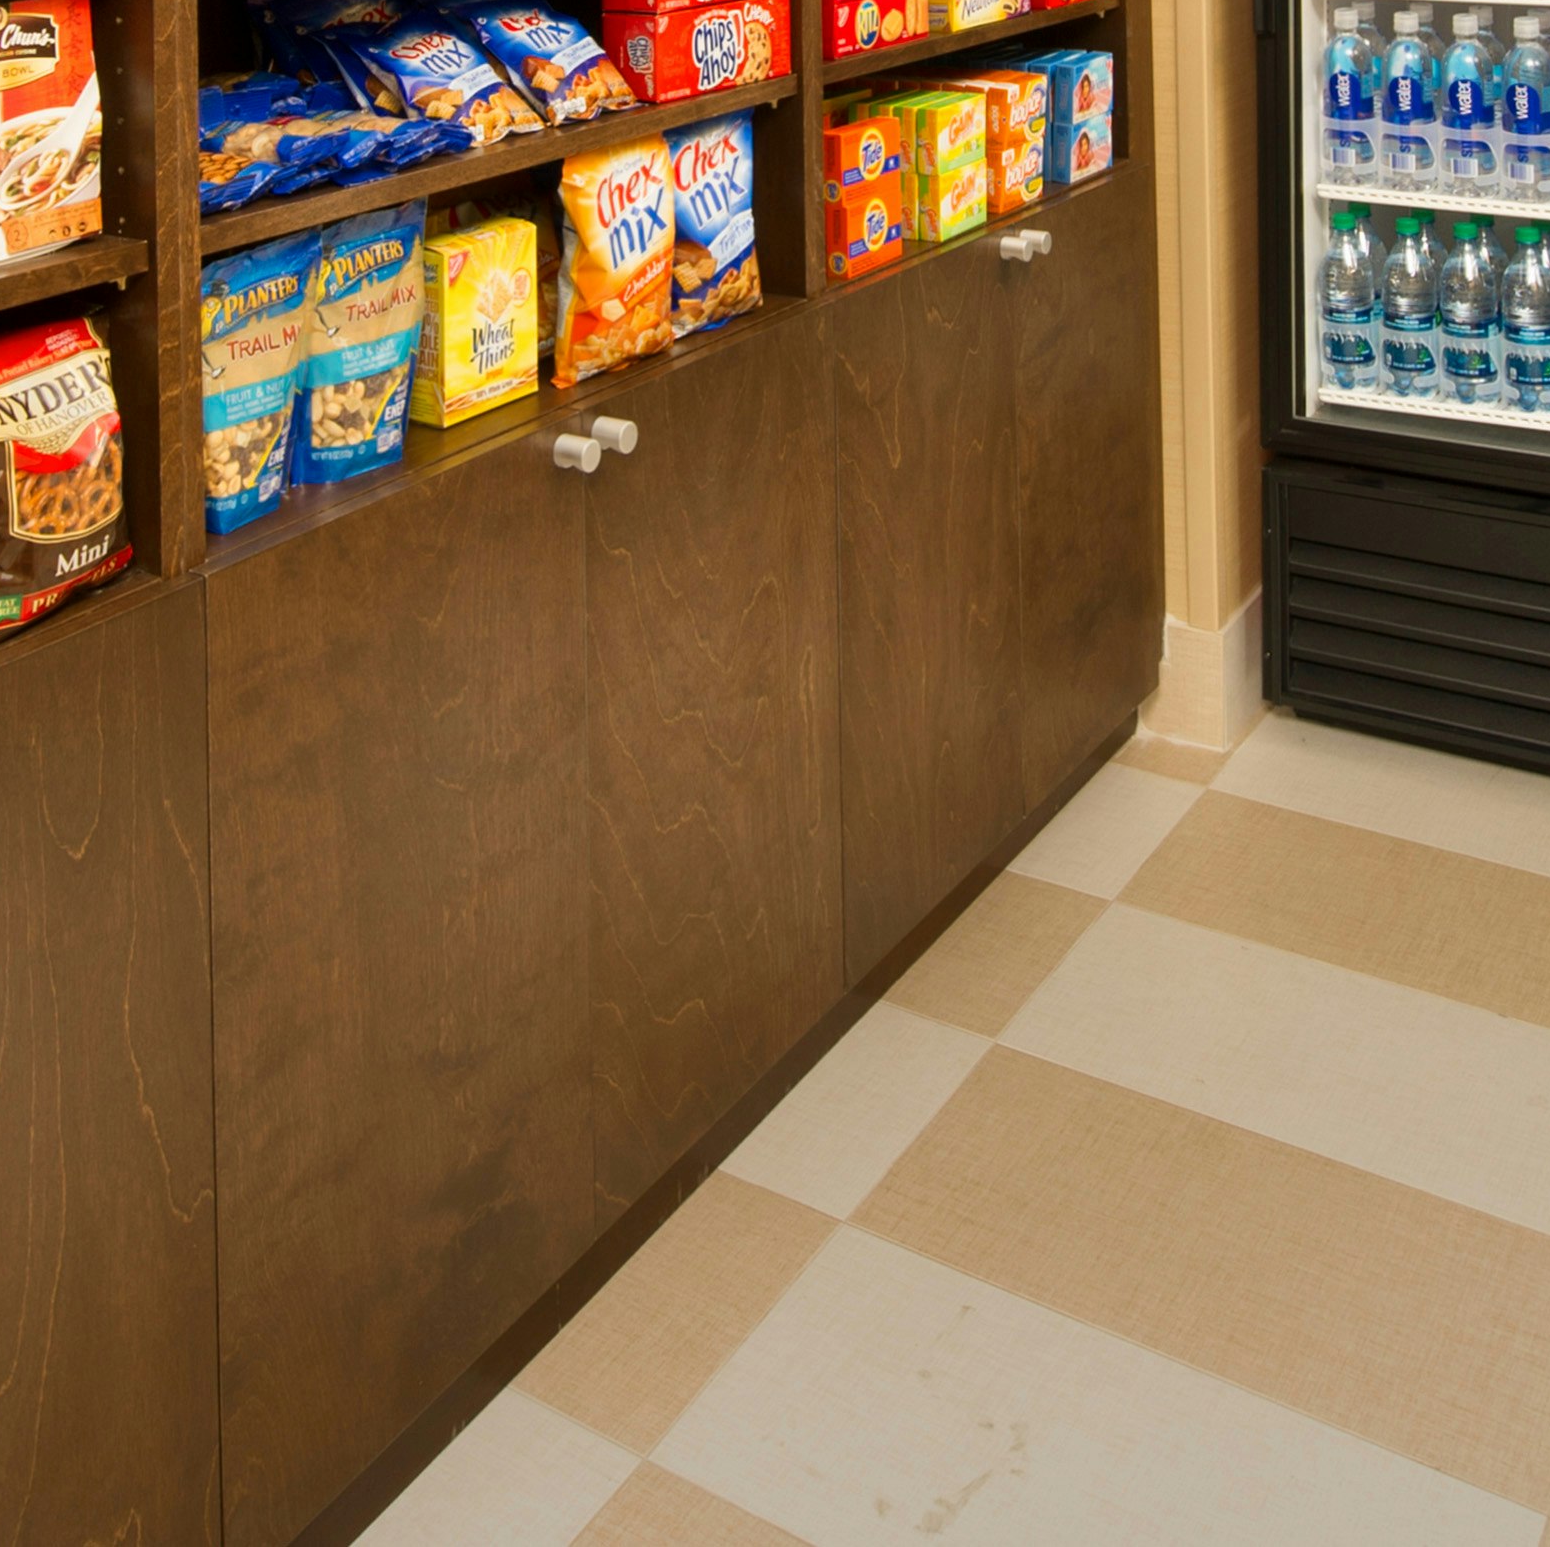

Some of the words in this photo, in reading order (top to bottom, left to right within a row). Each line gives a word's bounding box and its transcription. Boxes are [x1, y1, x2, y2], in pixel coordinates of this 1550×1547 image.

[693, 20, 733, 65] Chips
[673, 118, 743, 193] Chex
[861, 141, 882, 167] Tide
[595, 151, 664, 230] Chex
[688, 155, 746, 227] mix
[608, 185, 669, 271] mix
[866, 212, 886, 237] Tide
[333, 240, 404, 285] PLANTERS
[623, 257, 668, 302] Cheddar
[222, 273, 299, 324] PLANTERS
[345, 301, 387, 323] TRAIL
[389, 284, 417, 307] MIX
[227, 336, 281, 362] TRAIL
[469, 340, 516, 375] Thins
[471, 317, 516, 353] Wheat
[34, 389, 111, 431] HANOVER
[54, 533, 111, 578] Mini
